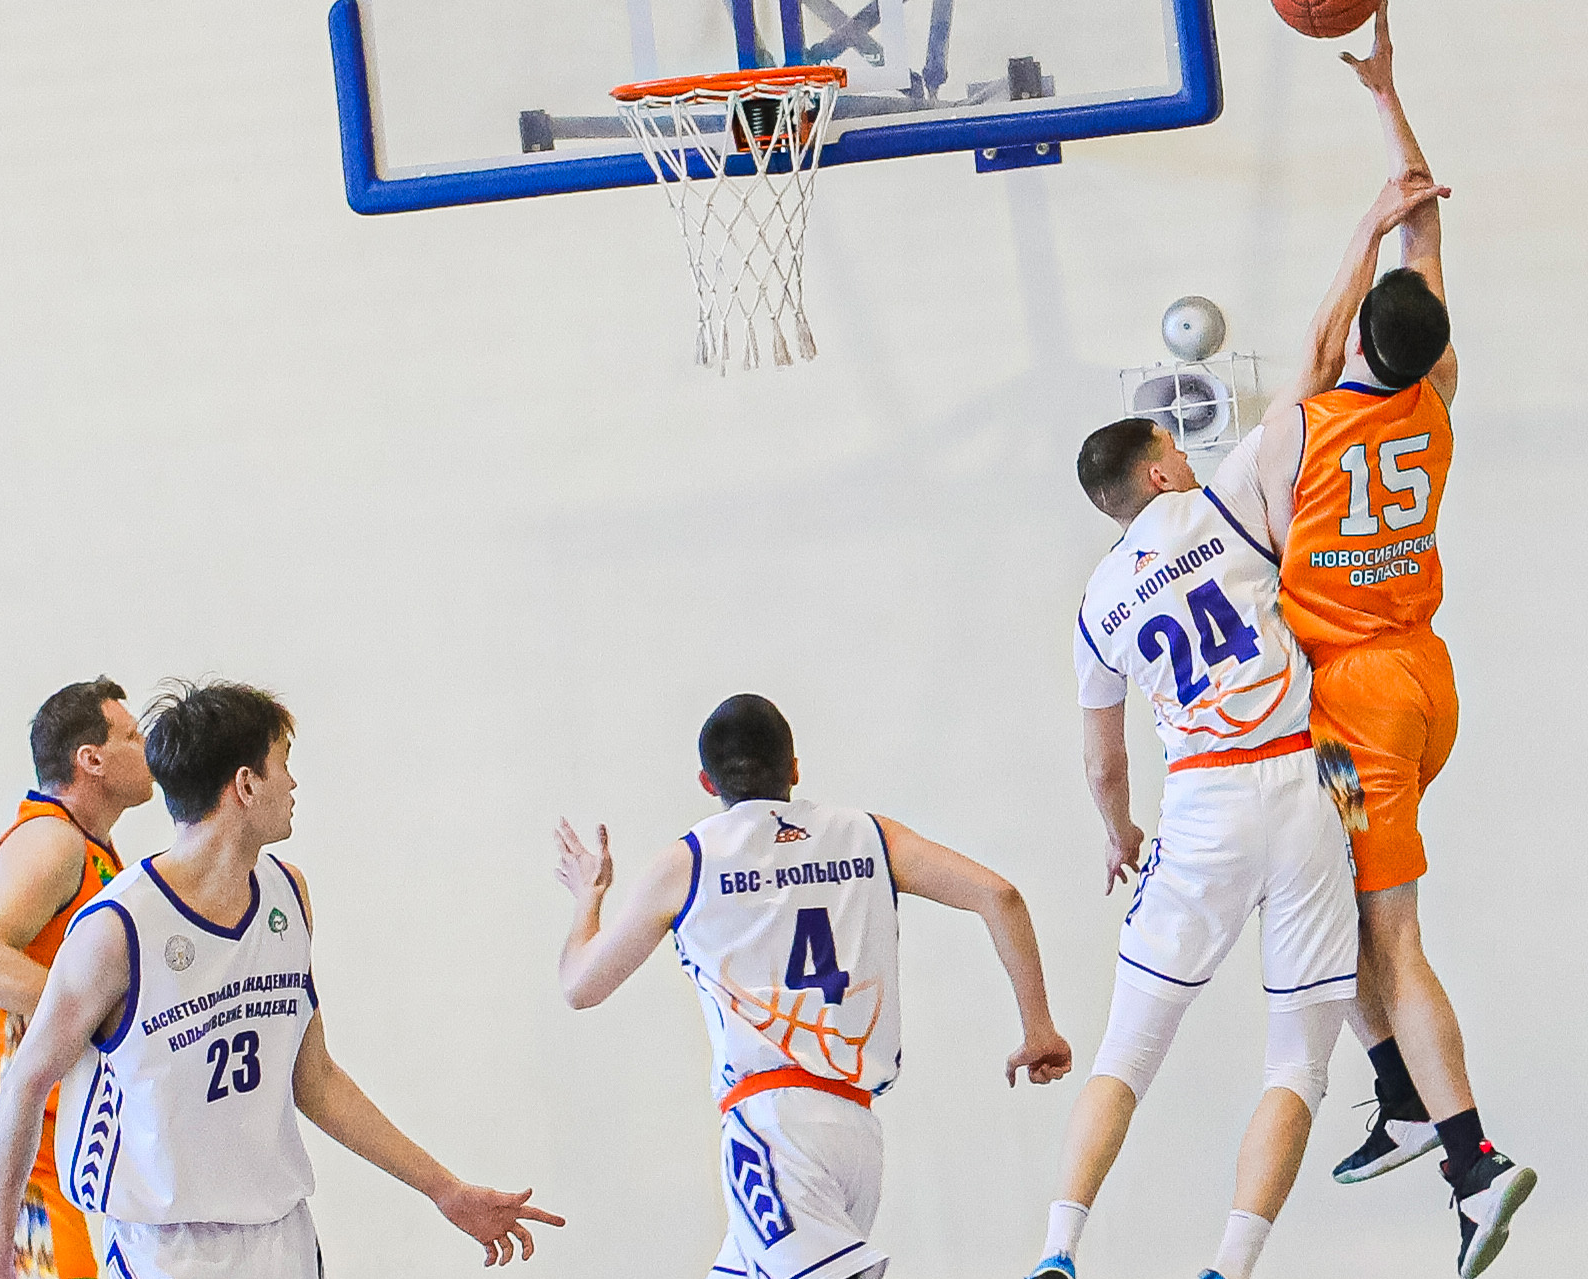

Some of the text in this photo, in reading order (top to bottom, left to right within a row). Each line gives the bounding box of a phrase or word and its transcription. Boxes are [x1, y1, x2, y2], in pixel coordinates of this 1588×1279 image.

[1338, 431, 1432, 537] 15
[1100, 601, 1132, 637] БВС
[1135, 537, 1225, 604] КОЛЬЦОВО
[1350, 559, 1420, 587] ОБЛАСТЬ
[1137, 578, 1261, 710] 24
[720, 870, 761, 895] БВС
[776, 856, 875, 889] КОЛЬЦОВО
[785, 907, 850, 1005] 4
[206, 1030, 262, 1103] 23
